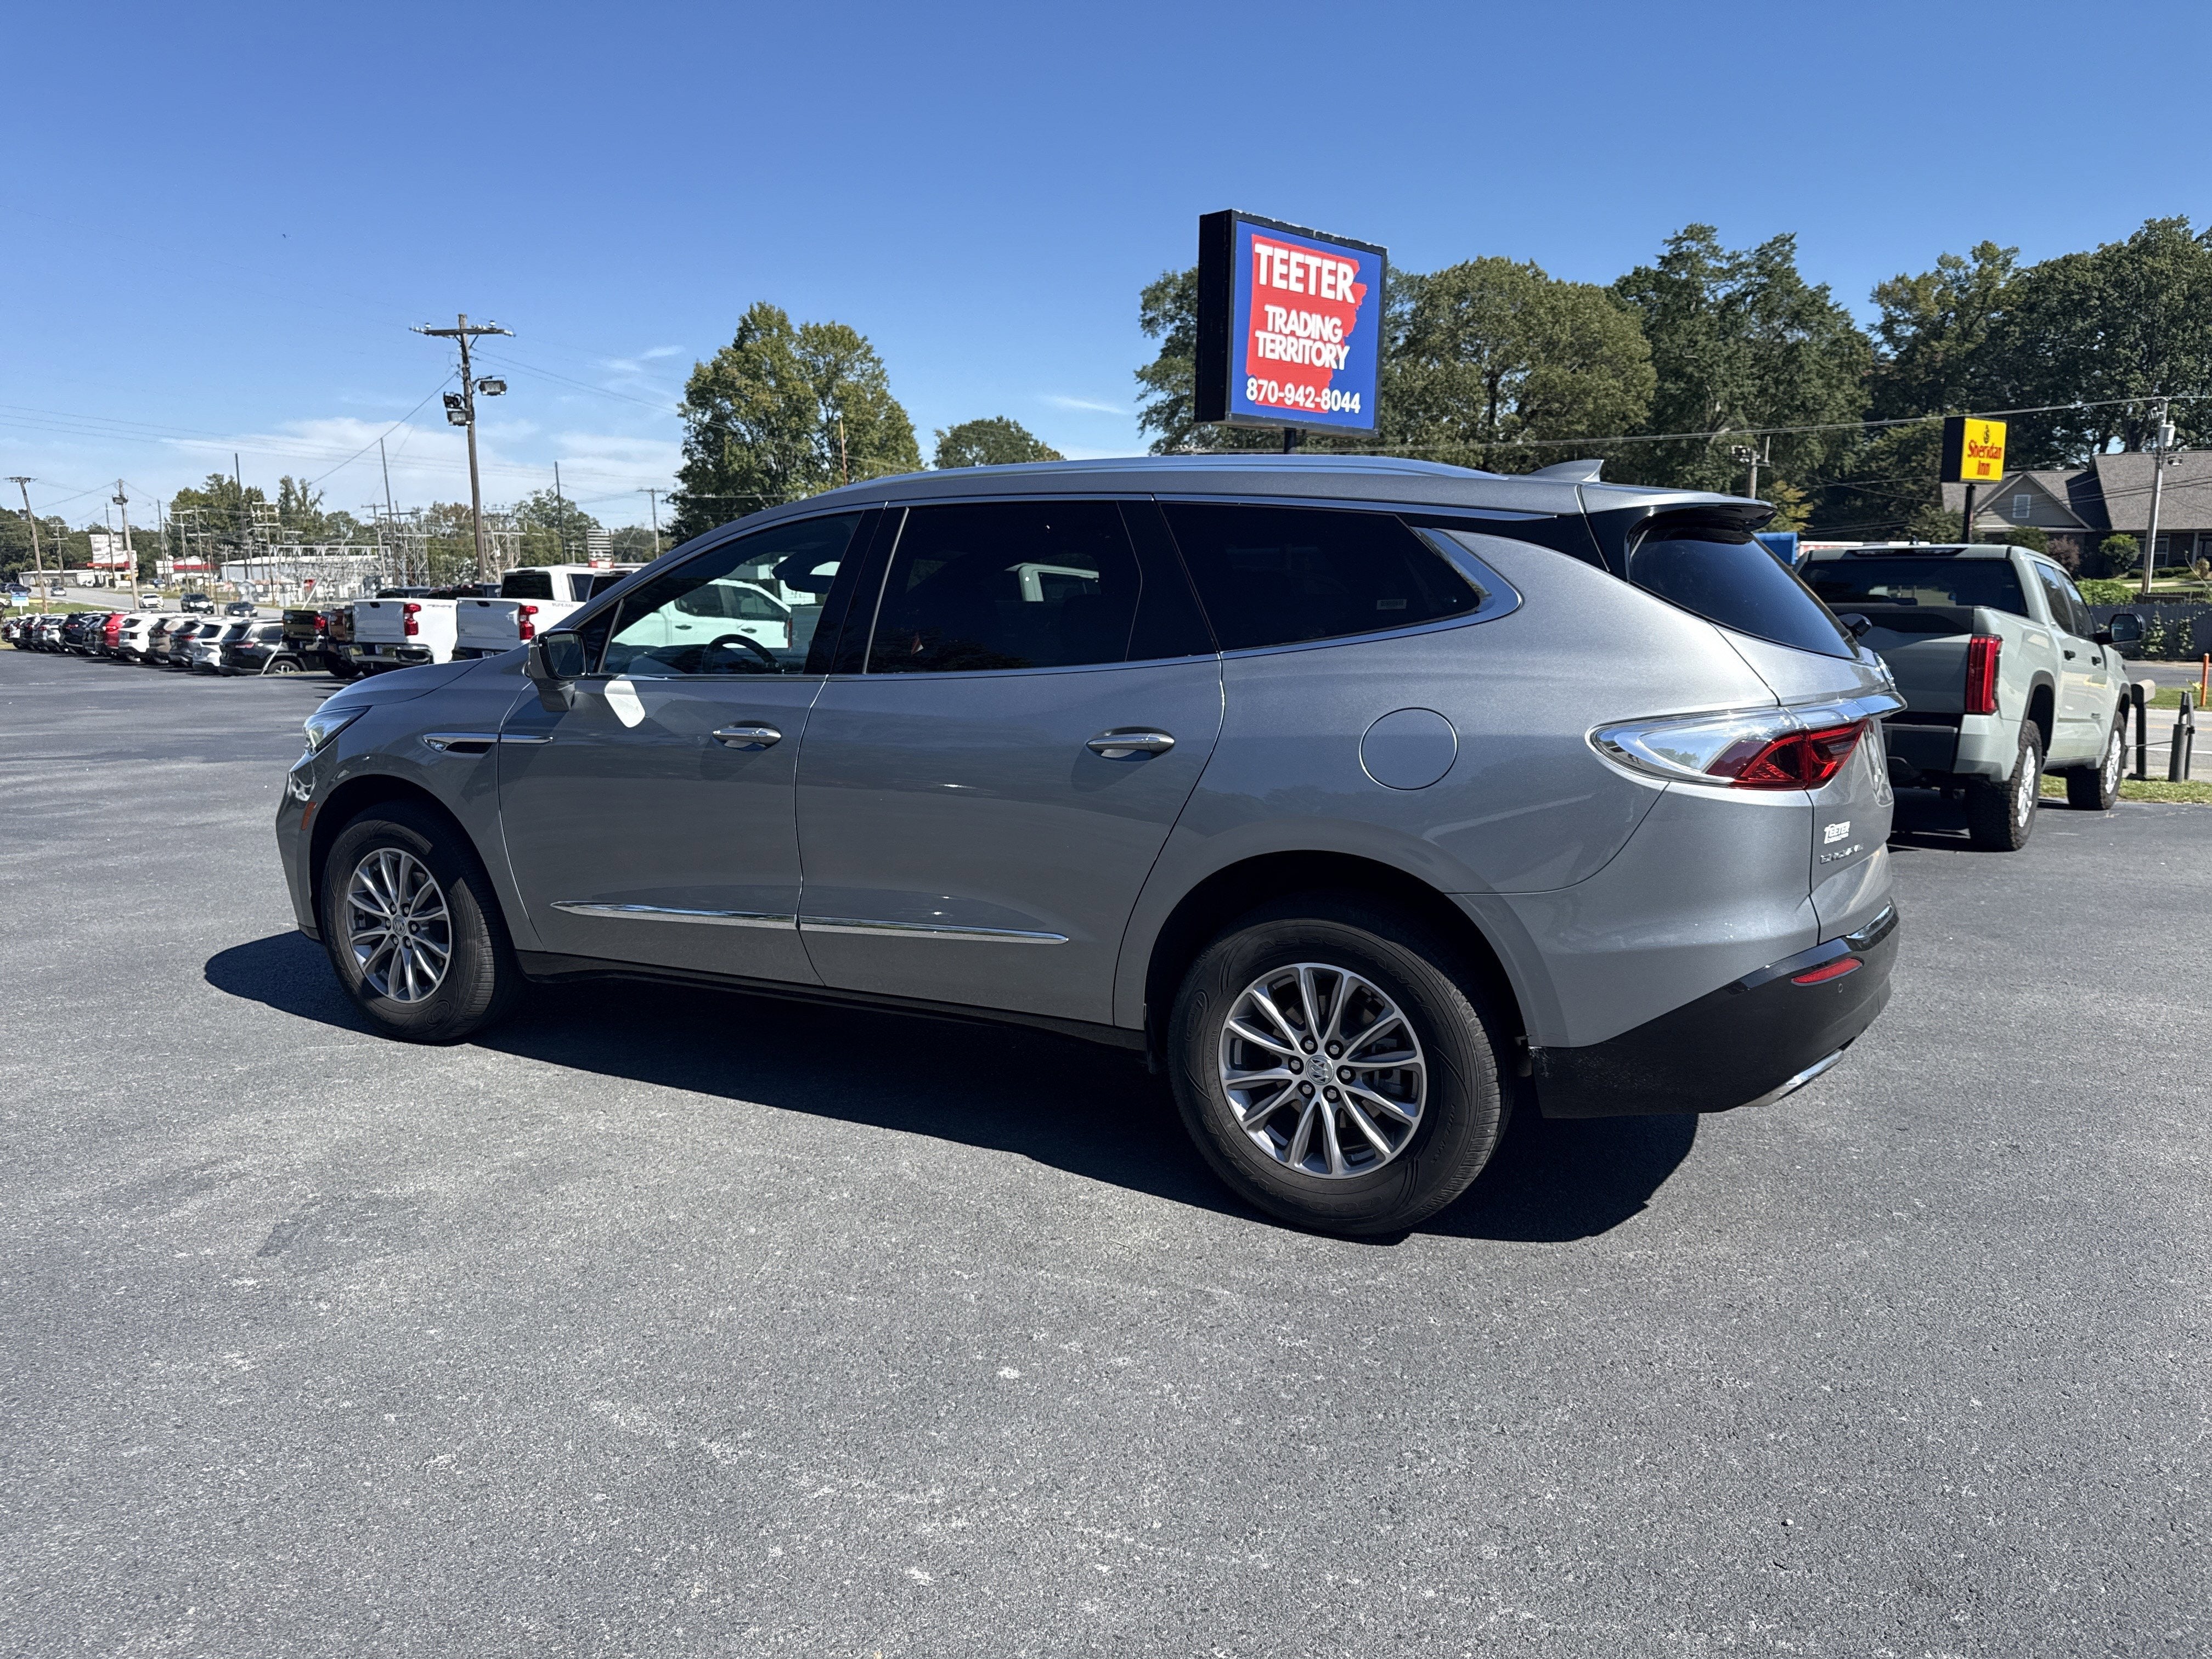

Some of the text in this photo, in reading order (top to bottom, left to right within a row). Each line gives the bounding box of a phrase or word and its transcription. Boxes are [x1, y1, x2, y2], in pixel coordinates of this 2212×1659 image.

[1255, 244, 1356, 304] TEETER
[1264, 304, 1343, 343] TRADING
[1255, 330, 1350, 370] TERRITORY
[1246, 377, 1361, 414] 870-942-8044
[1824, 821, 1850, 843] TEETER
[1253, 934, 1440, 1026] ASSURANCE
[1201, 1114, 1384, 1213] GOODYEAR
